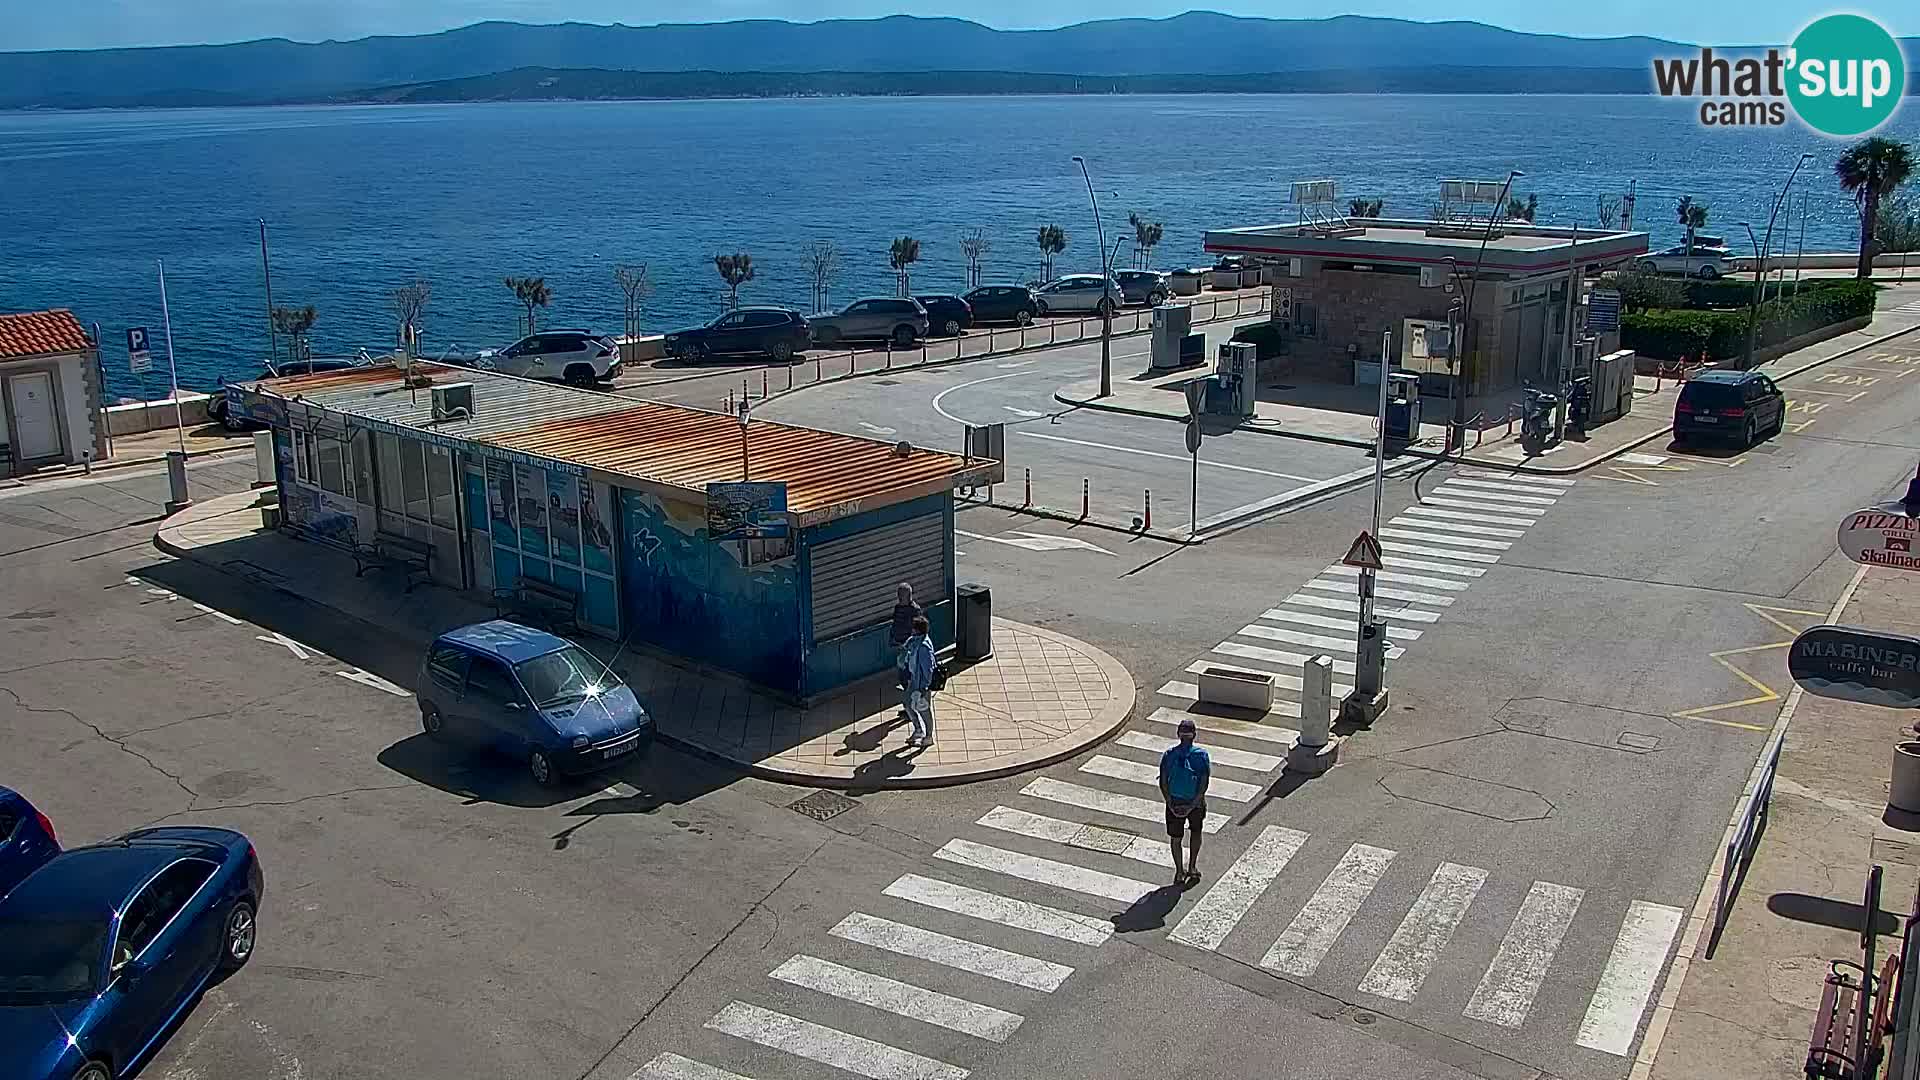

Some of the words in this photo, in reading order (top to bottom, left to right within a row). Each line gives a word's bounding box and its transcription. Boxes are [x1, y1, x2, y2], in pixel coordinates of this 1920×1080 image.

[131, 330, 143, 349] P
[1815, 373, 1880, 387] TAXI
[480, 446, 494, 457] BUS
[496, 449, 527, 464] STATION
[529, 457, 555, 470] TICKET
[556, 462, 583, 477] OFFICE
[1829, 661, 1866, 674] caffe
[1871, 665, 1897, 679] bar
